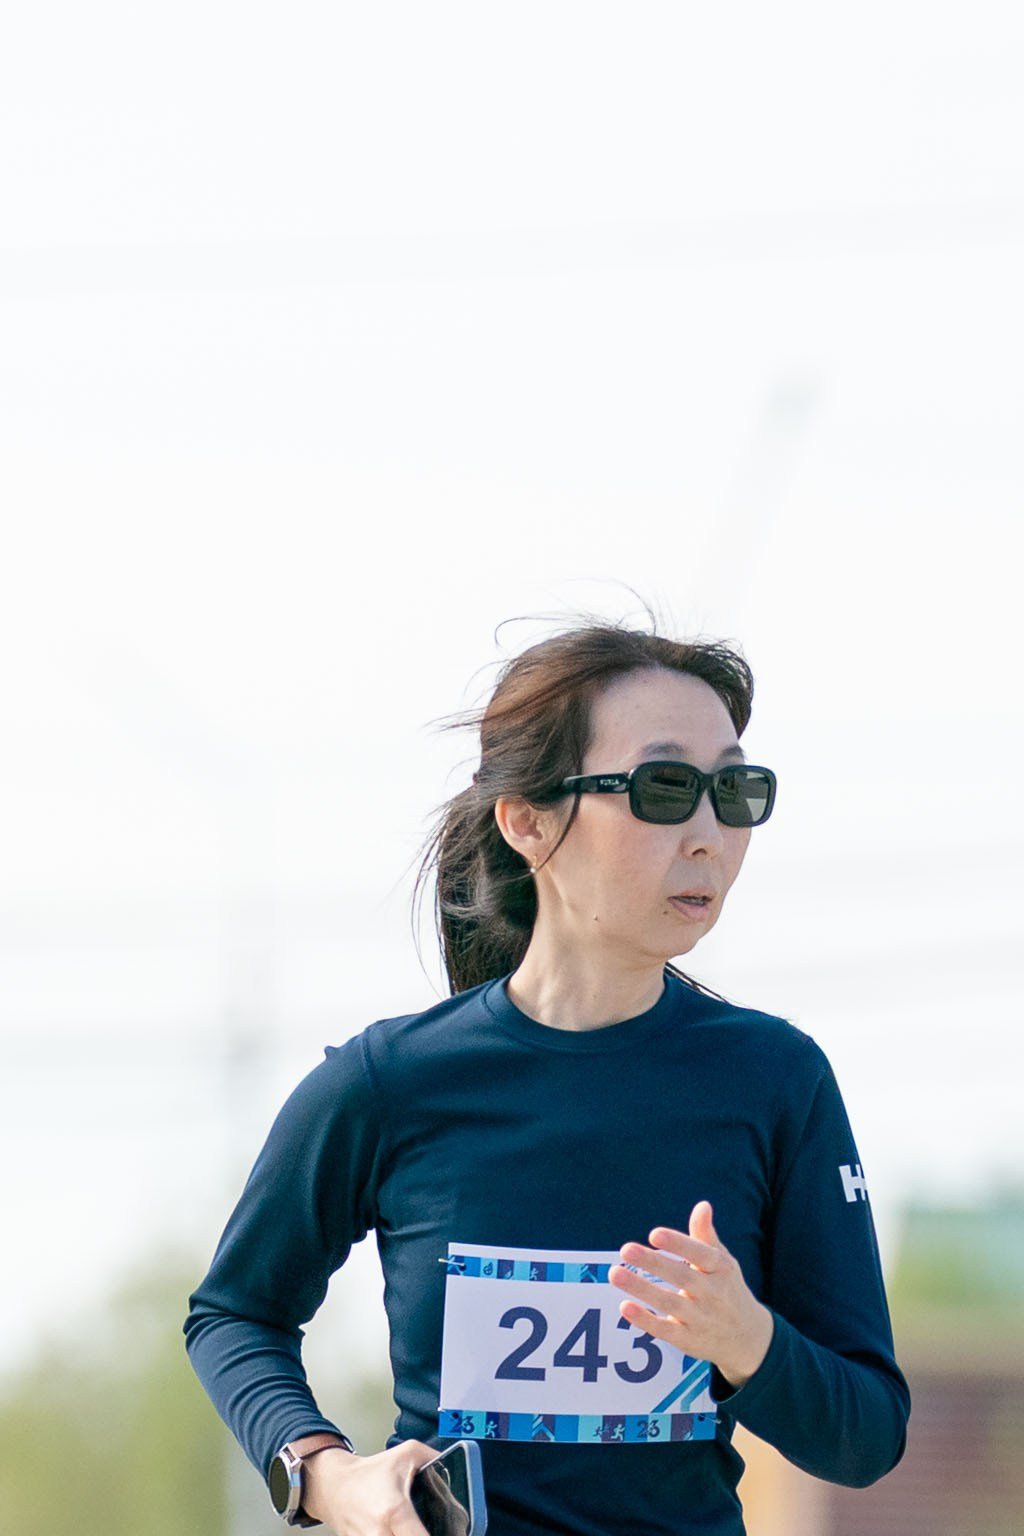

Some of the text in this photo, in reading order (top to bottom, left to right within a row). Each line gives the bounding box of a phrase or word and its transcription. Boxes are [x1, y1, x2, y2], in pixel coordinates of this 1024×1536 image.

[494, 1306, 663, 1384] 243
[448, 1414, 475, 1435] 23
[636, 1419, 660, 1438] 23
